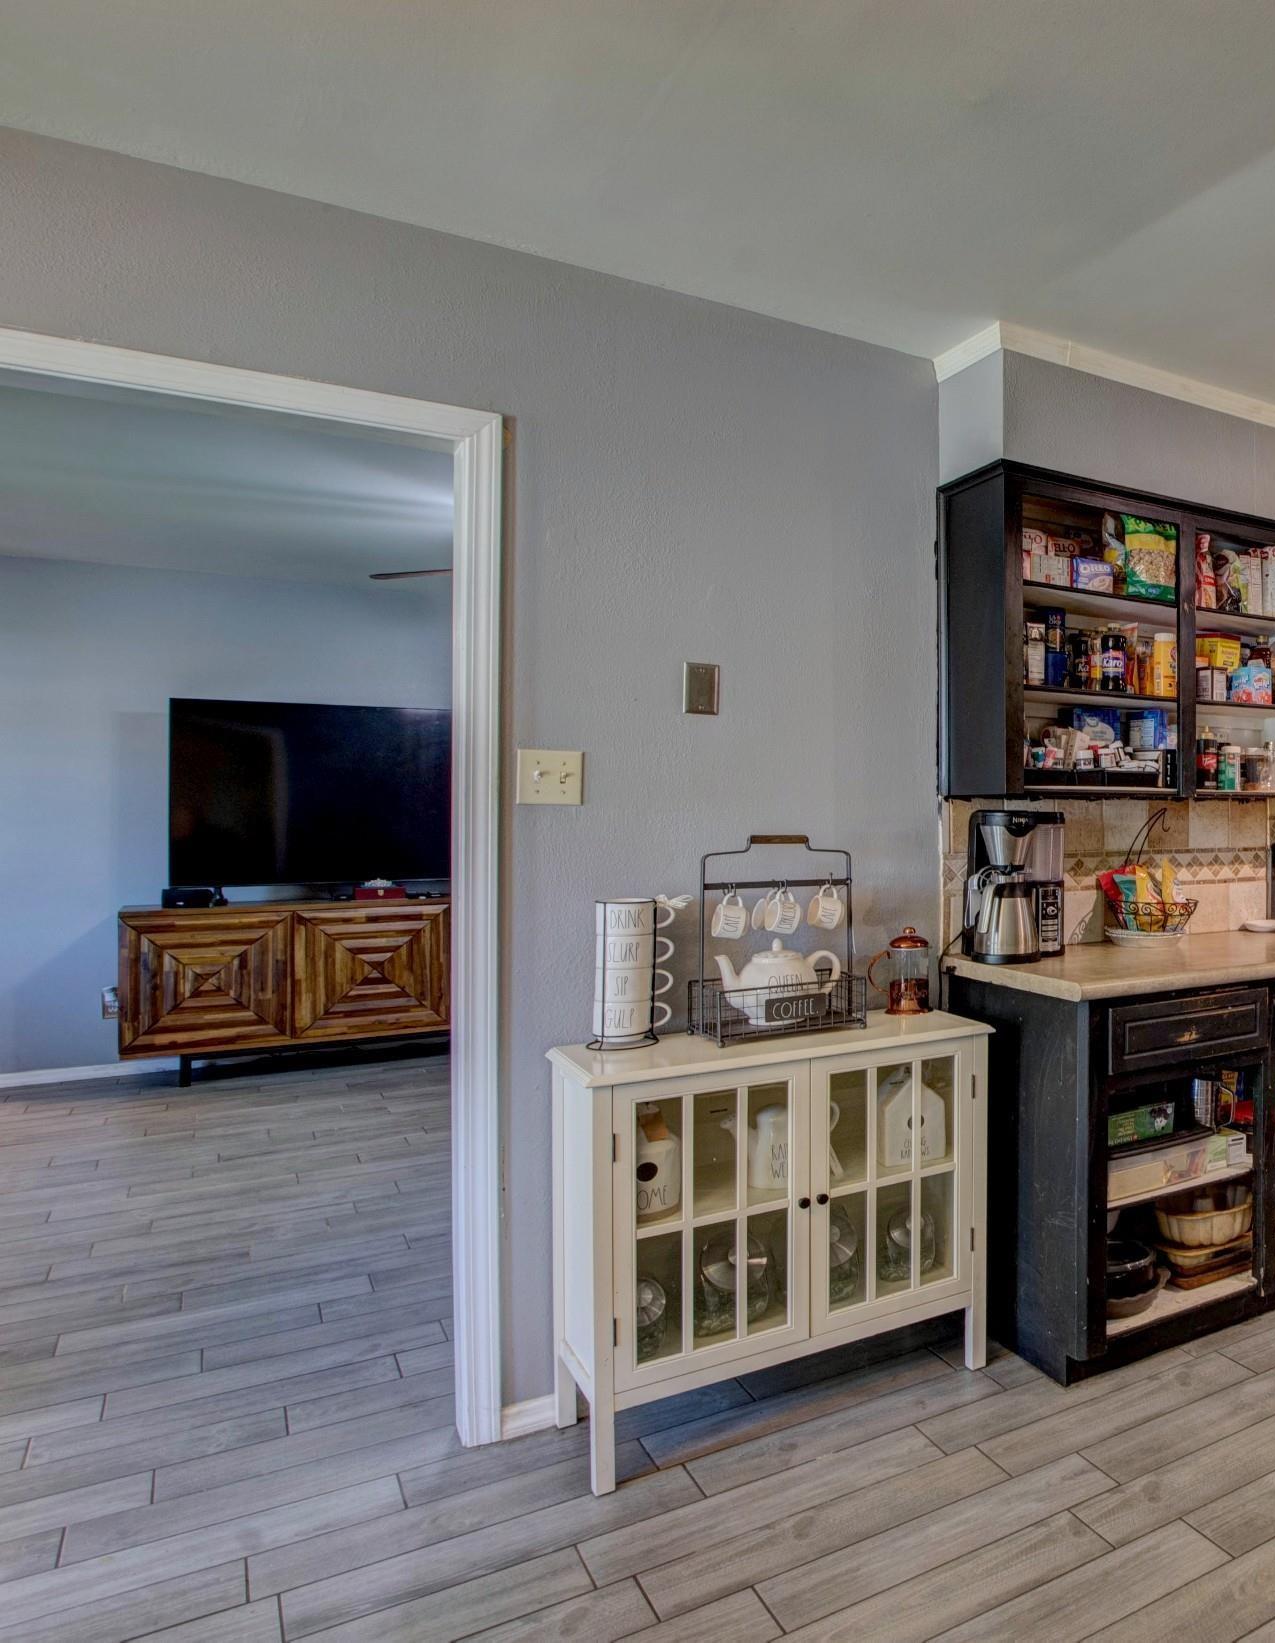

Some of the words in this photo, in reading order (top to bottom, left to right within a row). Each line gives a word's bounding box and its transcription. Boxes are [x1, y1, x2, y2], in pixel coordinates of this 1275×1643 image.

[1103, 657, 1122, 668] Karo
[609, 908, 646, 929] DRINK
[607, 942, 640, 962] SLURP
[613, 975, 629, 997] SIP
[768, 973, 804, 994] QUEEN
[605, 1007, 636, 1029] GULP
[636, 1184, 667, 1210] OME
